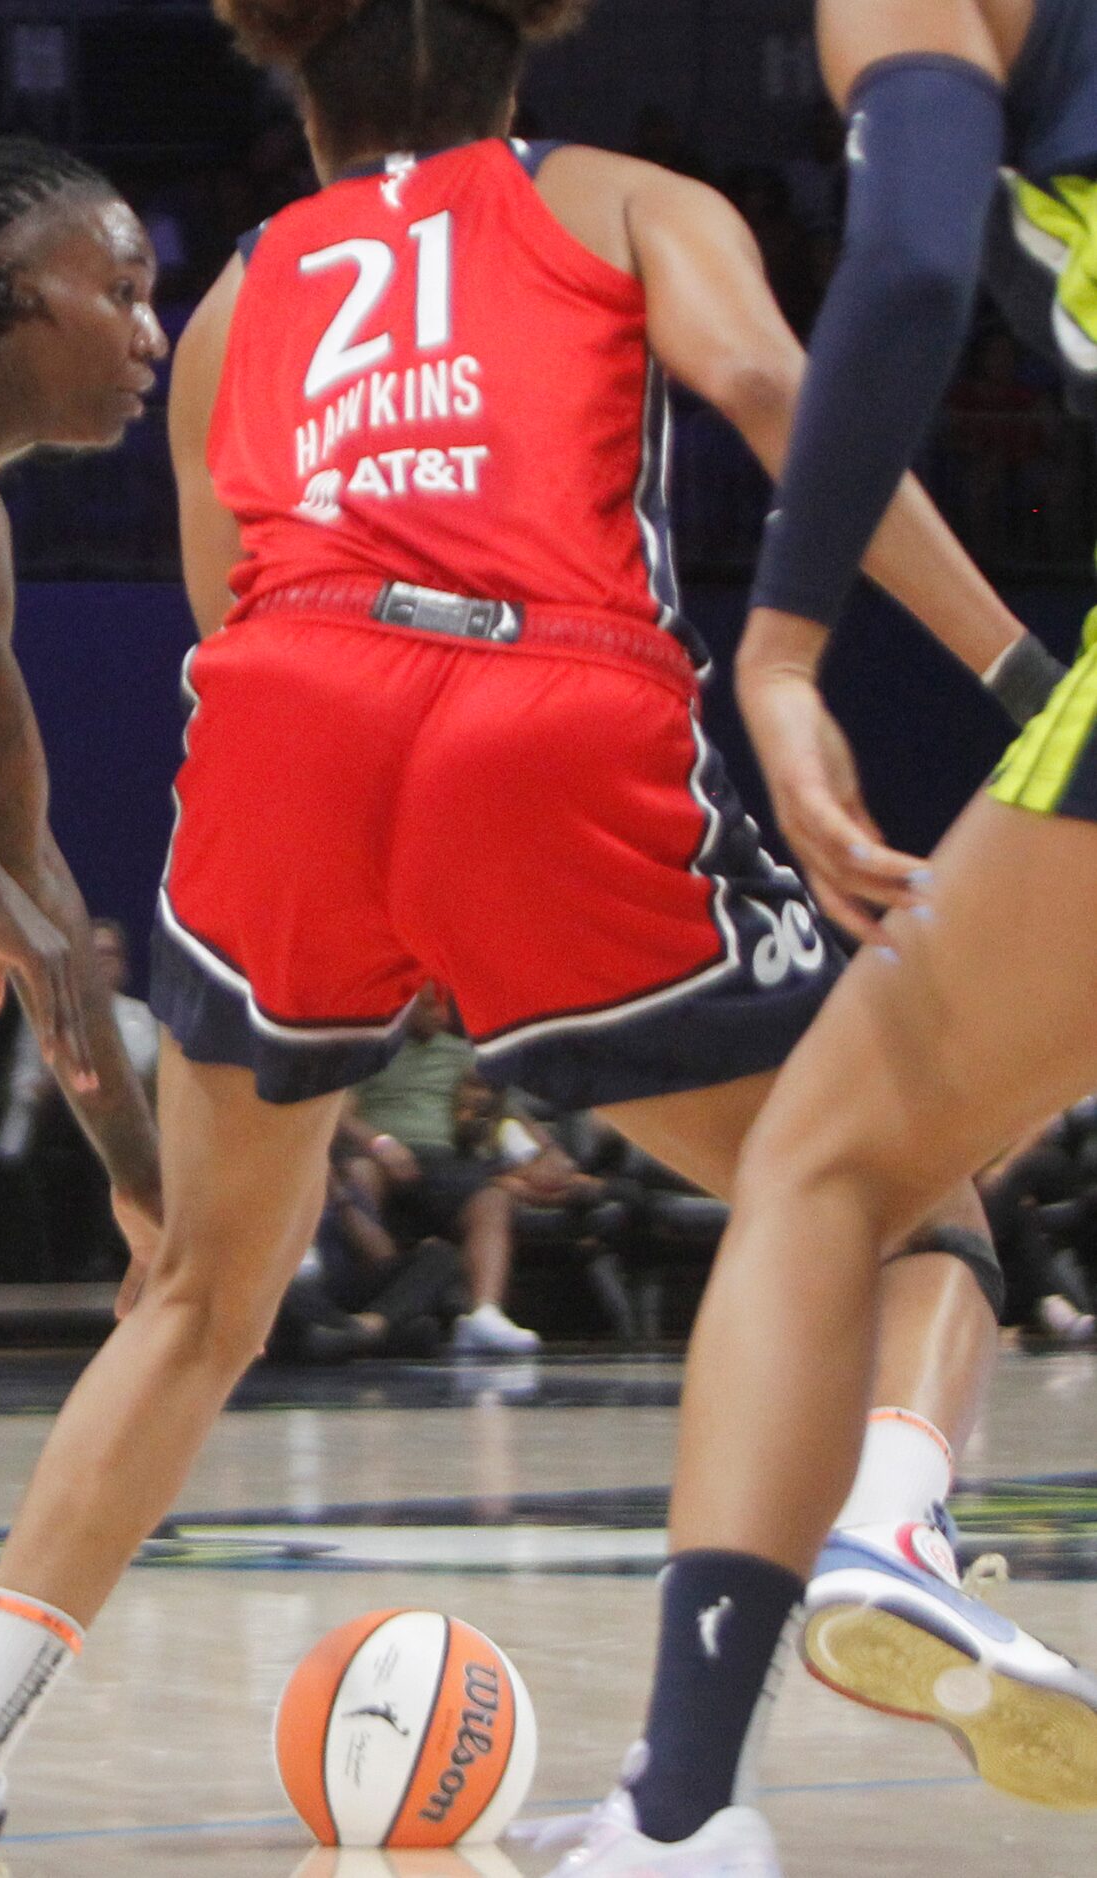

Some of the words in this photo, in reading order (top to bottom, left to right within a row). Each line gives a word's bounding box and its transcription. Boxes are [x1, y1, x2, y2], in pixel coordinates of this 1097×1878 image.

[299, 209, 451, 399] 21
[295, 354, 482, 478] HAWKINS
[347, 446, 490, 497] AT&T
[418, 1661, 500, 1823] Wilson
